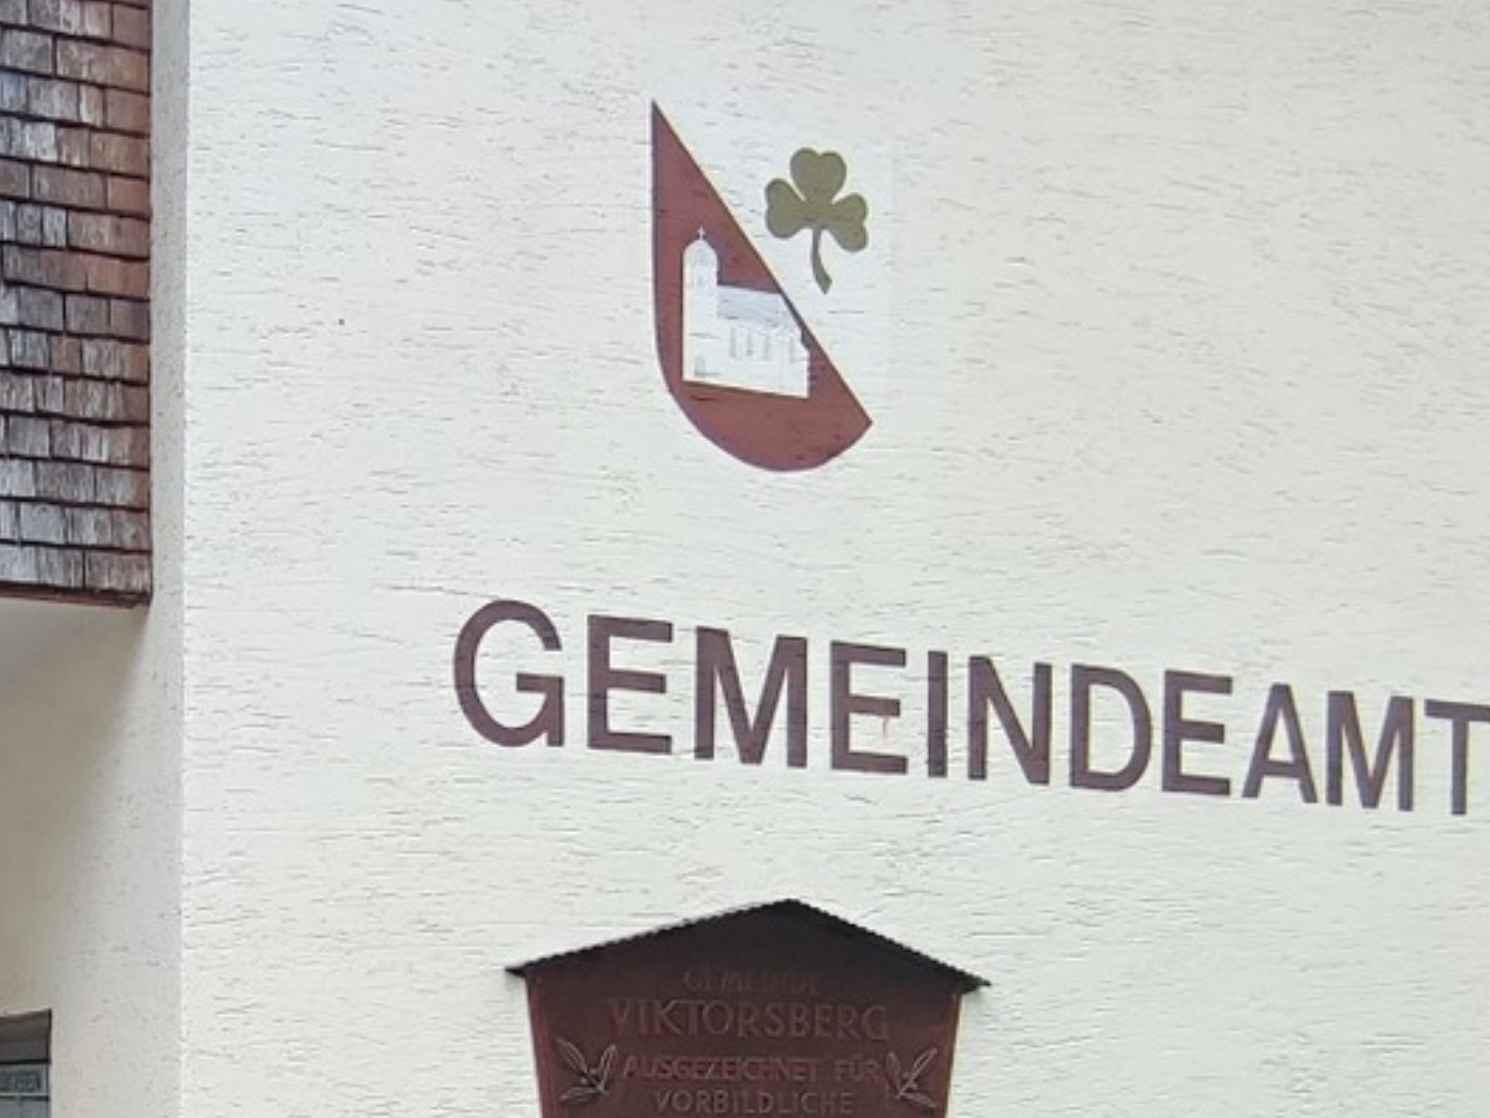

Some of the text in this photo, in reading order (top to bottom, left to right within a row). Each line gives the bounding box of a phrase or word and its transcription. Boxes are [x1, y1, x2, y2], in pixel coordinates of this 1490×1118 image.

[452, 598, 1490, 816] GEMEINDEAMT
[612, 999, 889, 1040] VIKTORSBERG
[623, 1055, 881, 1083] AUSGEZEICHNET FÜR
[656, 1091, 853, 1115] VORBILDLICHE
